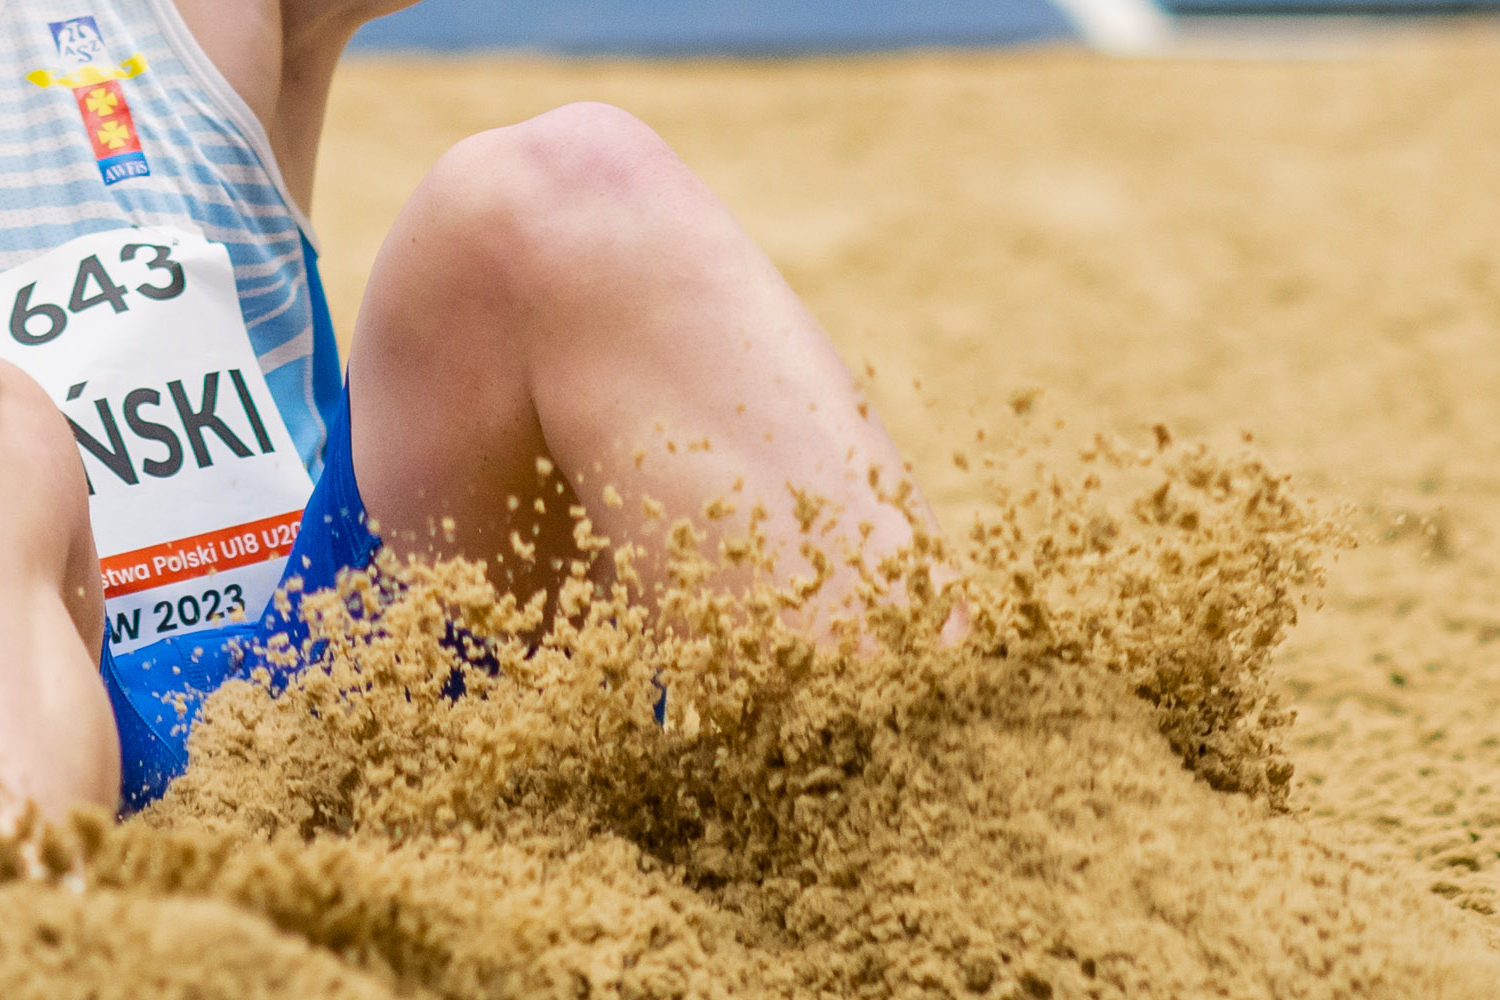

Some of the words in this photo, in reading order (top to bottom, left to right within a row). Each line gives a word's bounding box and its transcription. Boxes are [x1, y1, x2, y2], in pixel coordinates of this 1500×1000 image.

[8, 243, 187, 346] 643
[60, 368, 276, 496] ŃSKI
[152, 542, 218, 576] Polski
[219, 532, 260, 559] U18
[153, 583, 246, 634] 2023
